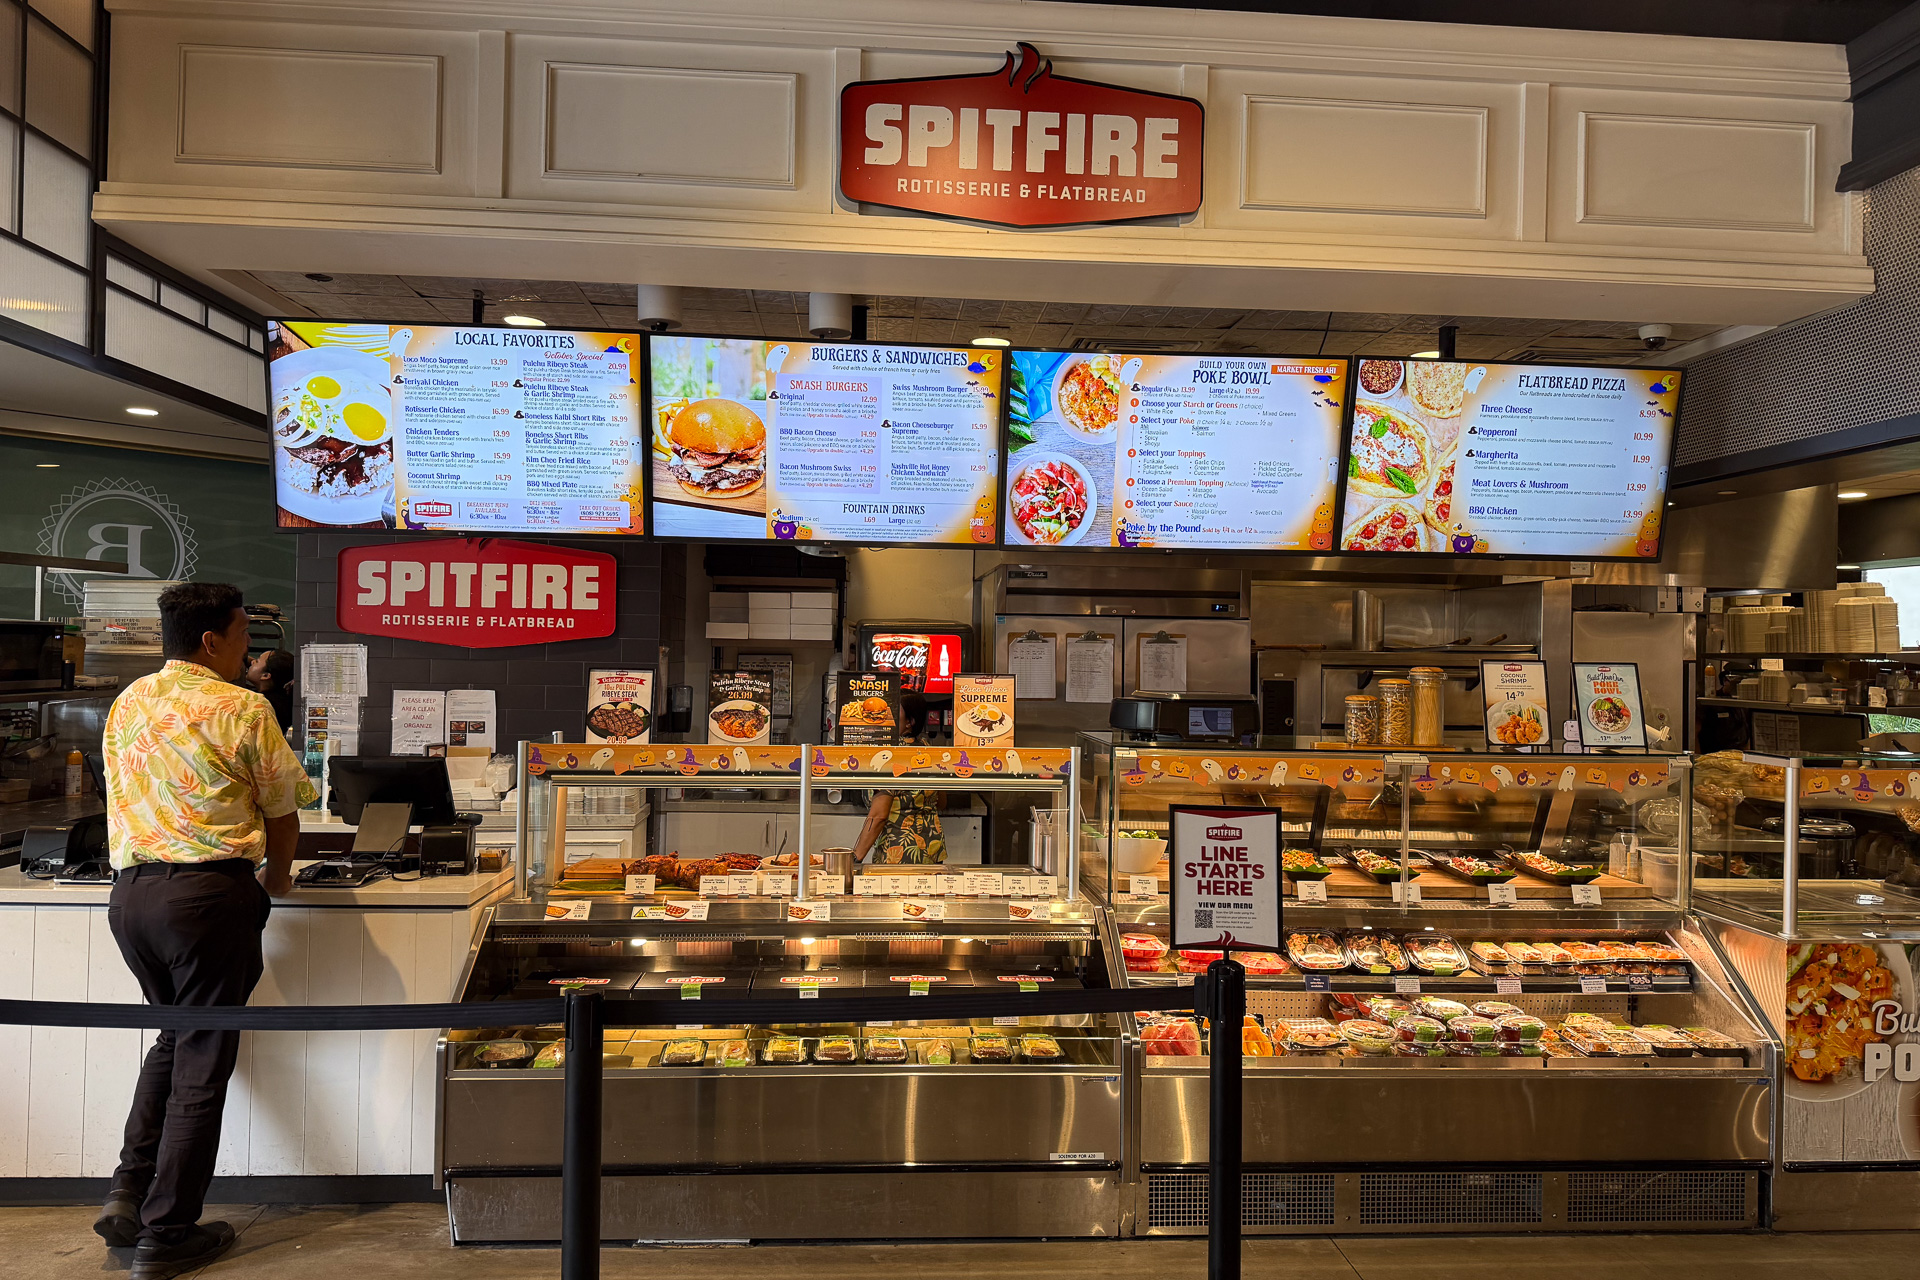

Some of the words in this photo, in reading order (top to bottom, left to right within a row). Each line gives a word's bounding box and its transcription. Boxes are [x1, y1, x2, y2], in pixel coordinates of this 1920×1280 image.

[864, 103, 1179, 179] SPITFIRE
[897, 177, 1011, 198] ROTISSERIE
[1019, 184, 1030, 198] &
[1038, 185, 1146, 203] FLATBREAD
[455, 331, 498, 346] LOCAL
[502, 333, 575, 349] FAVORITES
[439, 357, 468, 365] Supreme
[544, 351, 574, 359] October
[575, 352, 604, 361] Special
[811, 347, 868, 363] BURGERS
[872, 349, 881, 363] &
[886, 350, 968, 366] SANDWICHES
[1199, 360, 1222, 369] BUILD
[1225, 361, 1246, 369] YOUR
[1247, 362, 1266, 370] OWN
[1277, 365, 1303, 373] MARKET
[1304, 366, 1323, 374] FRESH
[404, 378, 431, 386] Teriyaki
[1192, 369, 1227, 384] POKE
[1231, 371, 1271, 385] BOWL
[790, 379, 822, 390] SMASH
[826, 381, 868, 392] BURGERS
[1518, 375, 1588, 391] FLATBREAD
[1592, 377, 1626, 391] PIZZA
[780, 393, 805, 401] Original
[439, 406, 465, 414] Chicken
[1166, 401, 1182, 409] your
[1215, 401, 1238, 409] Greens
[1481, 404, 1503, 412] Three
[1505, 405, 1533, 414] Cheese
[1639, 410, 1656, 418] 8.99
[1141, 416, 1161, 424] Select
[1162, 417, 1178, 425] your
[434, 428, 459, 436] Tenders
[1478, 427, 1517, 437] Pepperoni
[1633, 433, 1654, 441] 10.99
[451, 451, 475, 459] Shrimp
[1160, 450, 1176, 458] your
[1177, 450, 1206, 459] Toppings
[1475, 450, 1518, 461] Margherita
[1633, 455, 1651, 463] 11.99
[1167, 478, 1196, 486] Premium
[1199, 479, 1224, 488] Topping
[1472, 479, 1491, 487] Meat
[1493, 479, 1518, 488] Lovers
[1520, 480, 1526, 488] &
[1529, 480, 1569, 489] Mushroom
[1626, 483, 1646, 491] 13.99
[843, 503, 889, 514] FOUNTAIN
[892, 505, 925, 514] DRINKS
[1469, 506, 1485, 515] BBQ
[1487, 507, 1518, 515] Chicken
[1623, 510, 1643, 518] 13.99
[1126, 523, 1145, 531] Poke
[1148, 524, 1157, 533] by
[1160, 524, 1173, 532] the
[1175, 524, 1201, 532] Pound
[356, 560, 599, 610] SPITFIRE
[382, 614, 470, 626] ROTISSERIE
[476, 615, 485, 627] &
[490, 616, 575, 629] FLATBREAD
[849, 679, 889, 691] SMASH
[960, 684, 981, 694] Loco
[983, 685, 1008, 693] Moco
[728, 691, 753, 700] 26.99
[1506, 691, 1524, 701] 14.79
[1594, 687, 1622, 695] BOWL
[961, 695, 1007, 703] SUPREME
[607, 736, 627, 744] 20.99
[1208, 828, 1241, 837] SPITFIRE
[1201, 846, 1248, 862] LINE
[1184, 862, 1265, 880] STARTS
[1197, 880, 1253, 896] HERE
